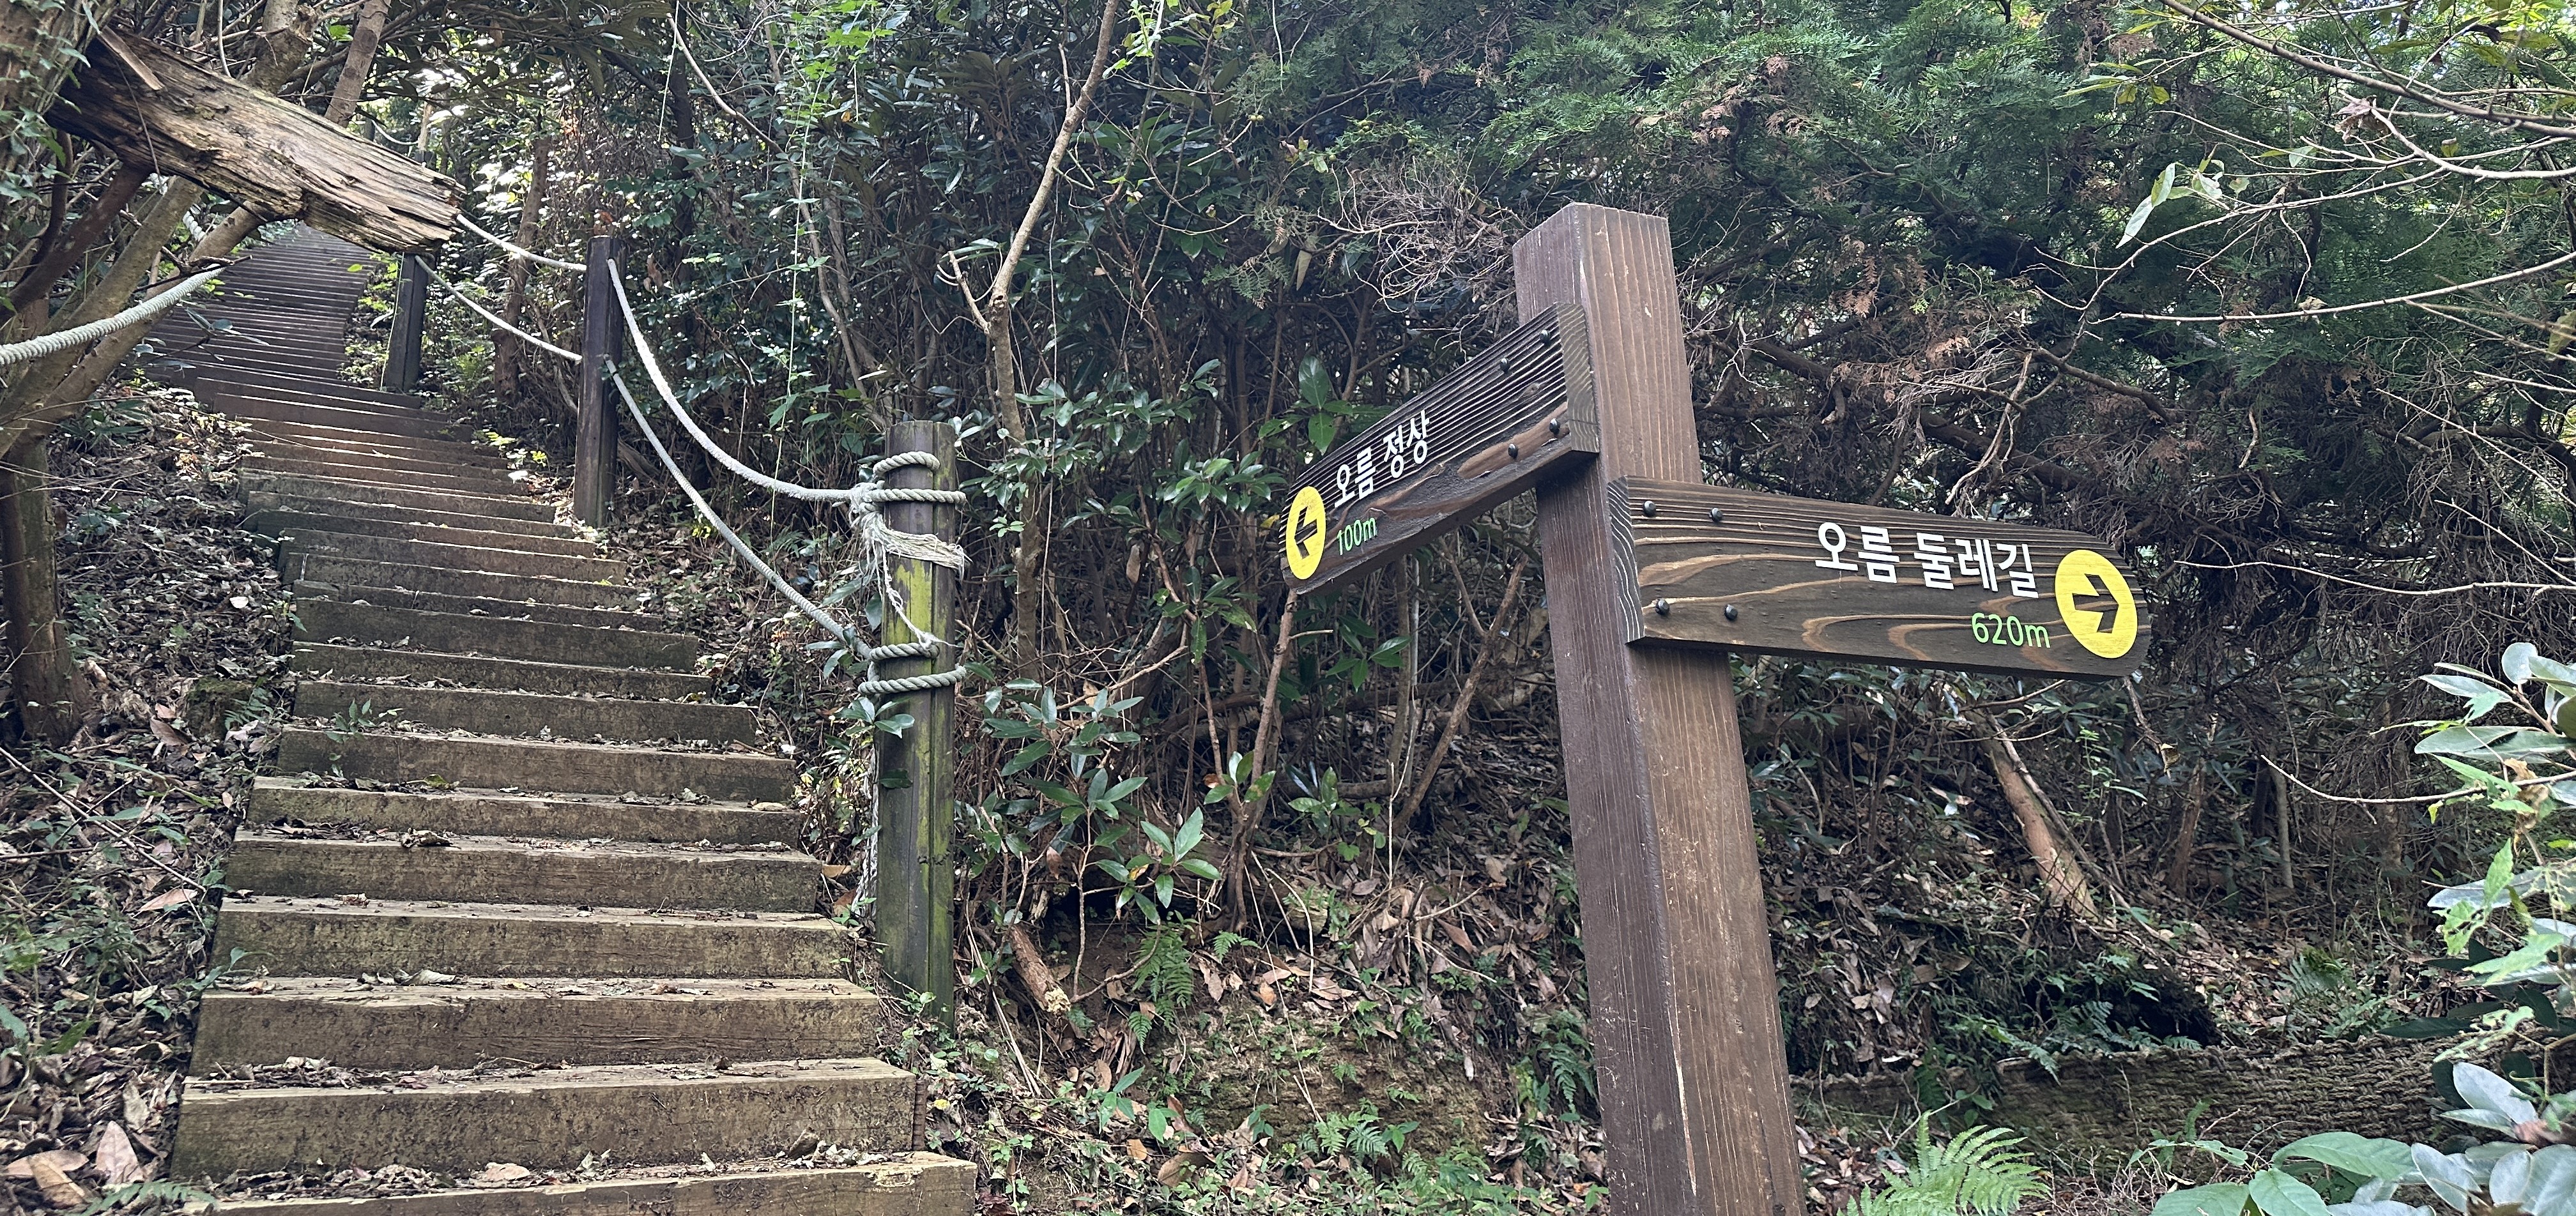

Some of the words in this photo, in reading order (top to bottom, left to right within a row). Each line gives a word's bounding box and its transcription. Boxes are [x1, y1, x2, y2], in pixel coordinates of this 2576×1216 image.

[1334, 446, 1376, 508] 오름
[1383, 409, 1430, 478] 정상
[1337, 517, 1378, 556] 100m
[1815, 522, 1899, 584] 오름
[1913, 532, 2039, 598] 둘레길
[1971, 612, 2051, 648] 620m
